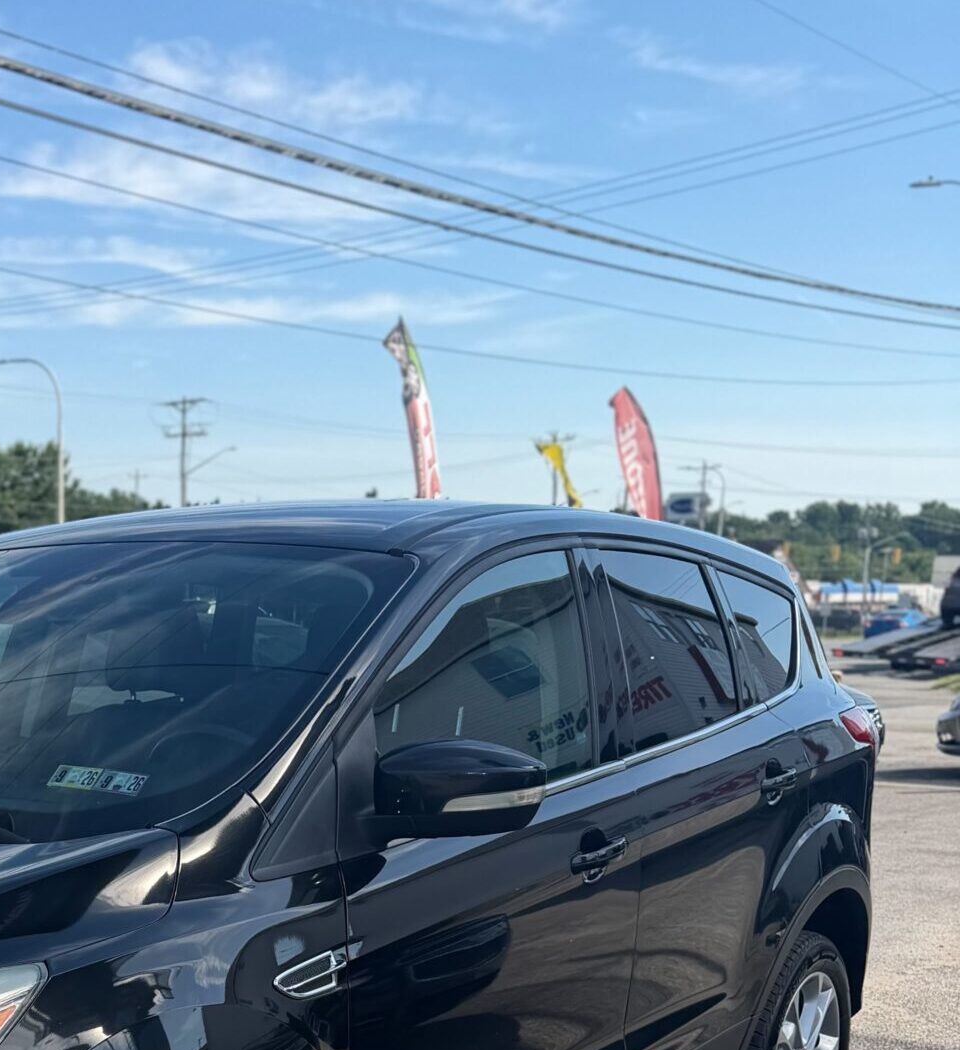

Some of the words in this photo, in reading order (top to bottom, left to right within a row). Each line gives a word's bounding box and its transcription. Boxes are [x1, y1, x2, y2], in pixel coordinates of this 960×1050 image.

[55, 770, 68, 783] 9
[81, 770, 98, 786] 26
[100, 775, 114, 788] 9
[127, 776, 145, 791] 26
